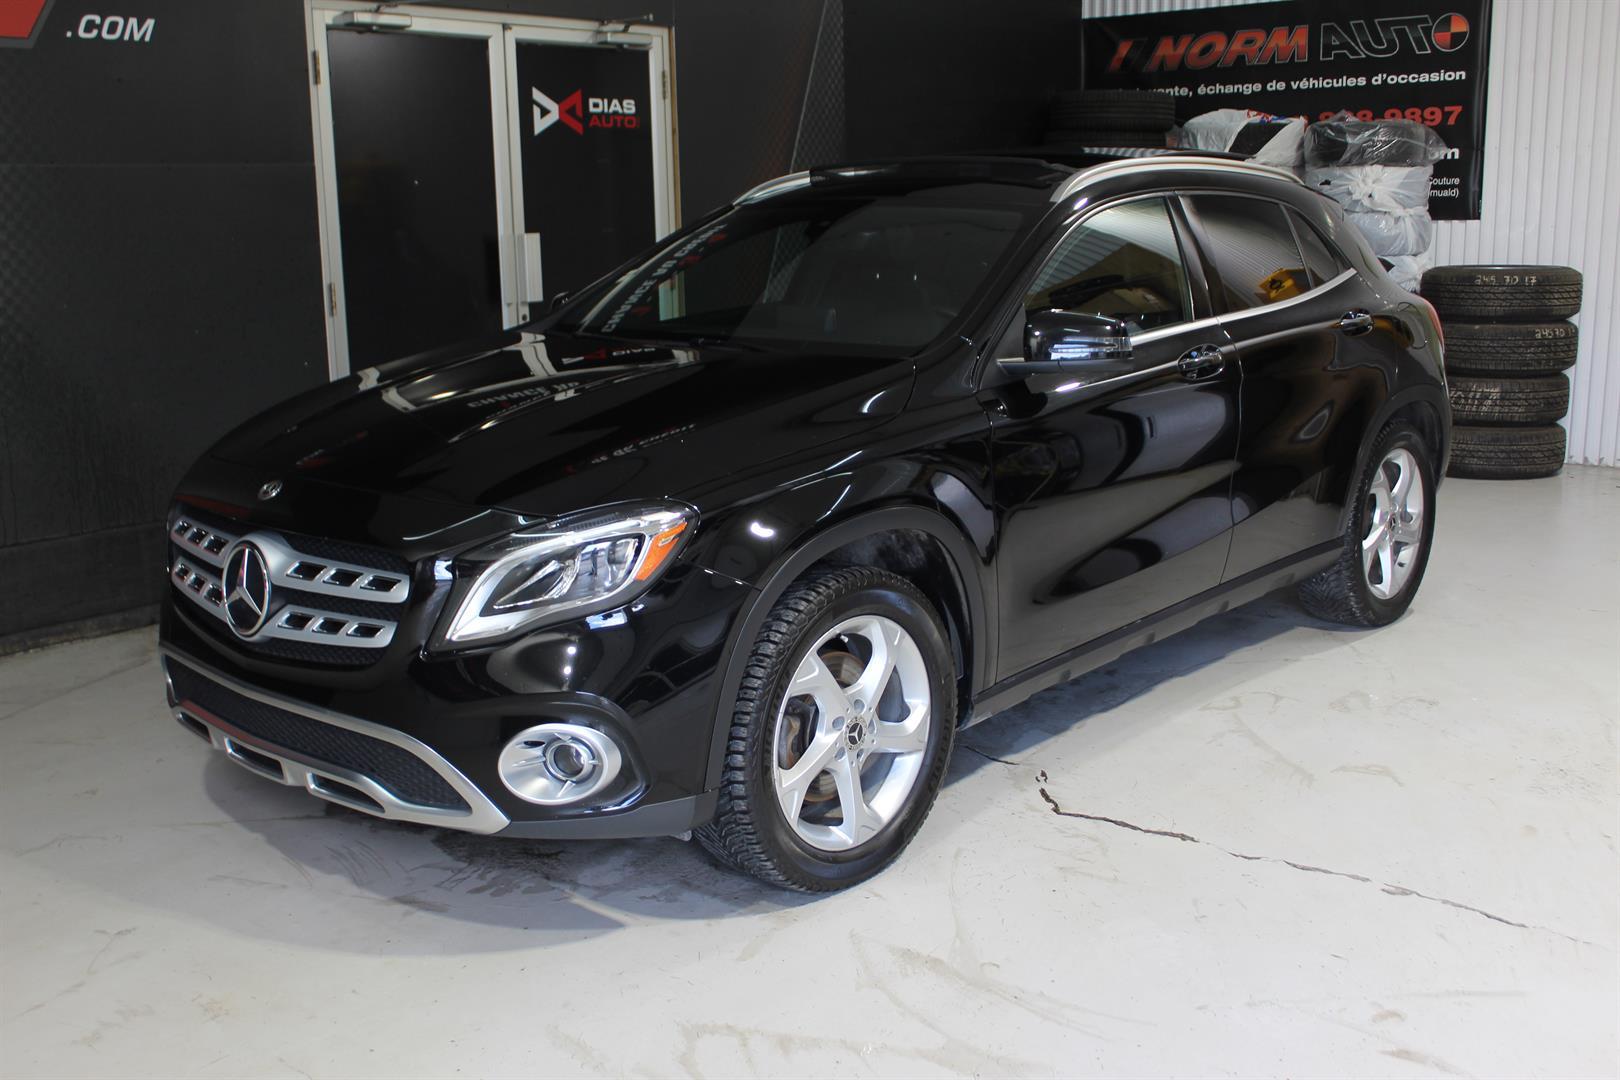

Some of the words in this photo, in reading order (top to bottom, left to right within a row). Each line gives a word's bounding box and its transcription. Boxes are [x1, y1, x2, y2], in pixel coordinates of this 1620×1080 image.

[66, 14, 155, 42] .COM
[1320, 12, 1470, 61] AUTO
[1197, 81, 1262, 96] échange
[1266, 78, 1287, 92] de
[1291, 75, 1367, 90] véhicules
[1371, 69, 1467, 86] d'occasion
[588, 97, 636, 114] DIAS
[588, 114, 637, 128] AUTO
